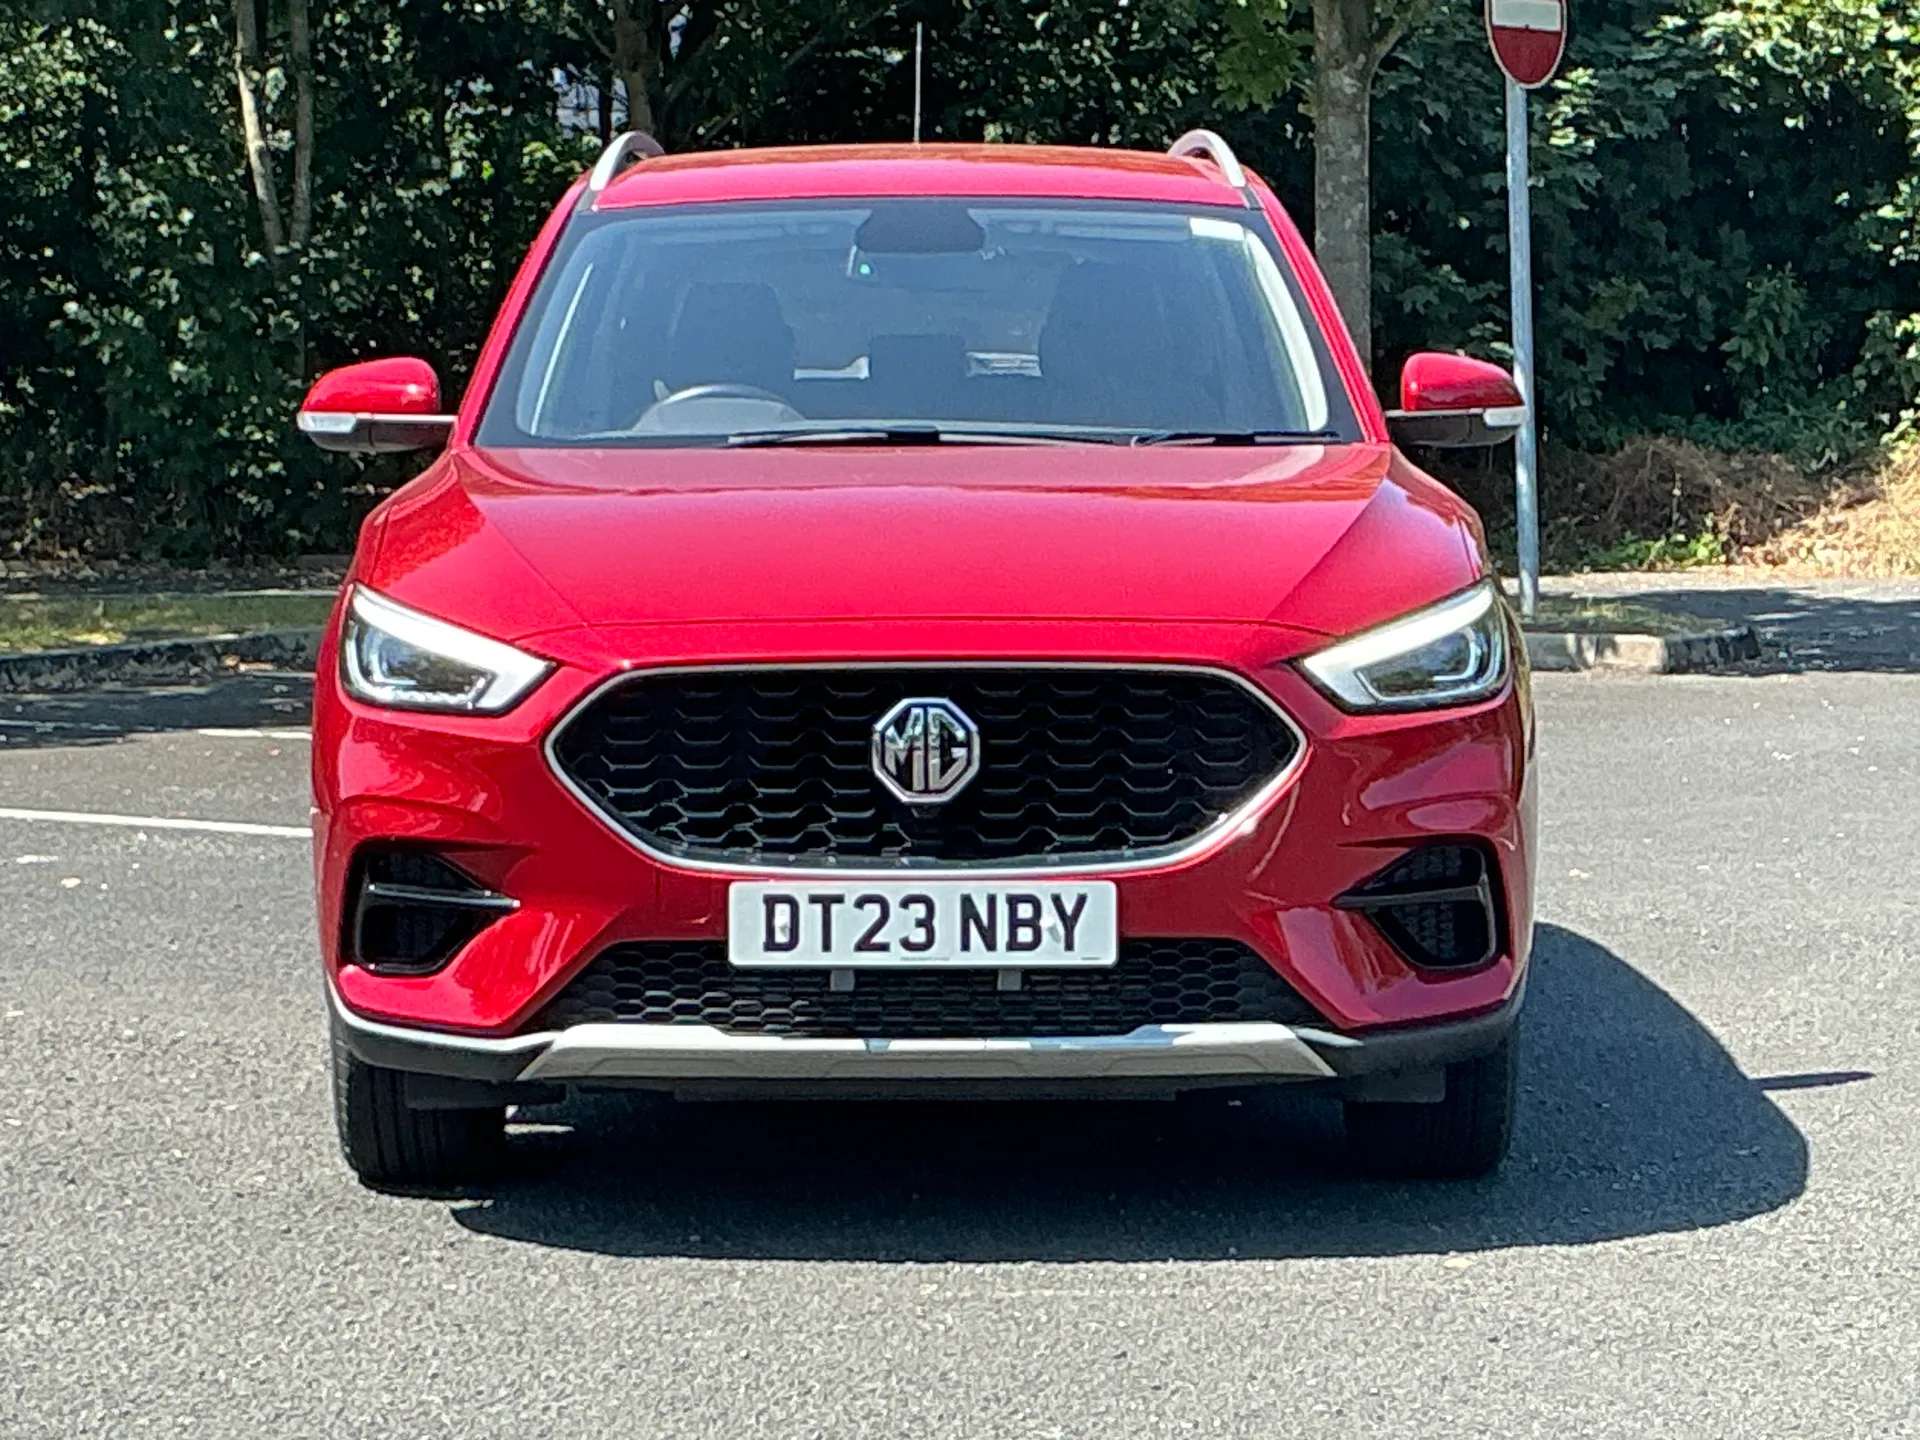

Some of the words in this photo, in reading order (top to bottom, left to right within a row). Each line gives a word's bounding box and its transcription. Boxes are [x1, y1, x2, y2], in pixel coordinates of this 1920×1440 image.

[884, 706, 968, 792] MG
[762, 893, 936, 953] DT23
[960, 893, 1088, 953] NBY
